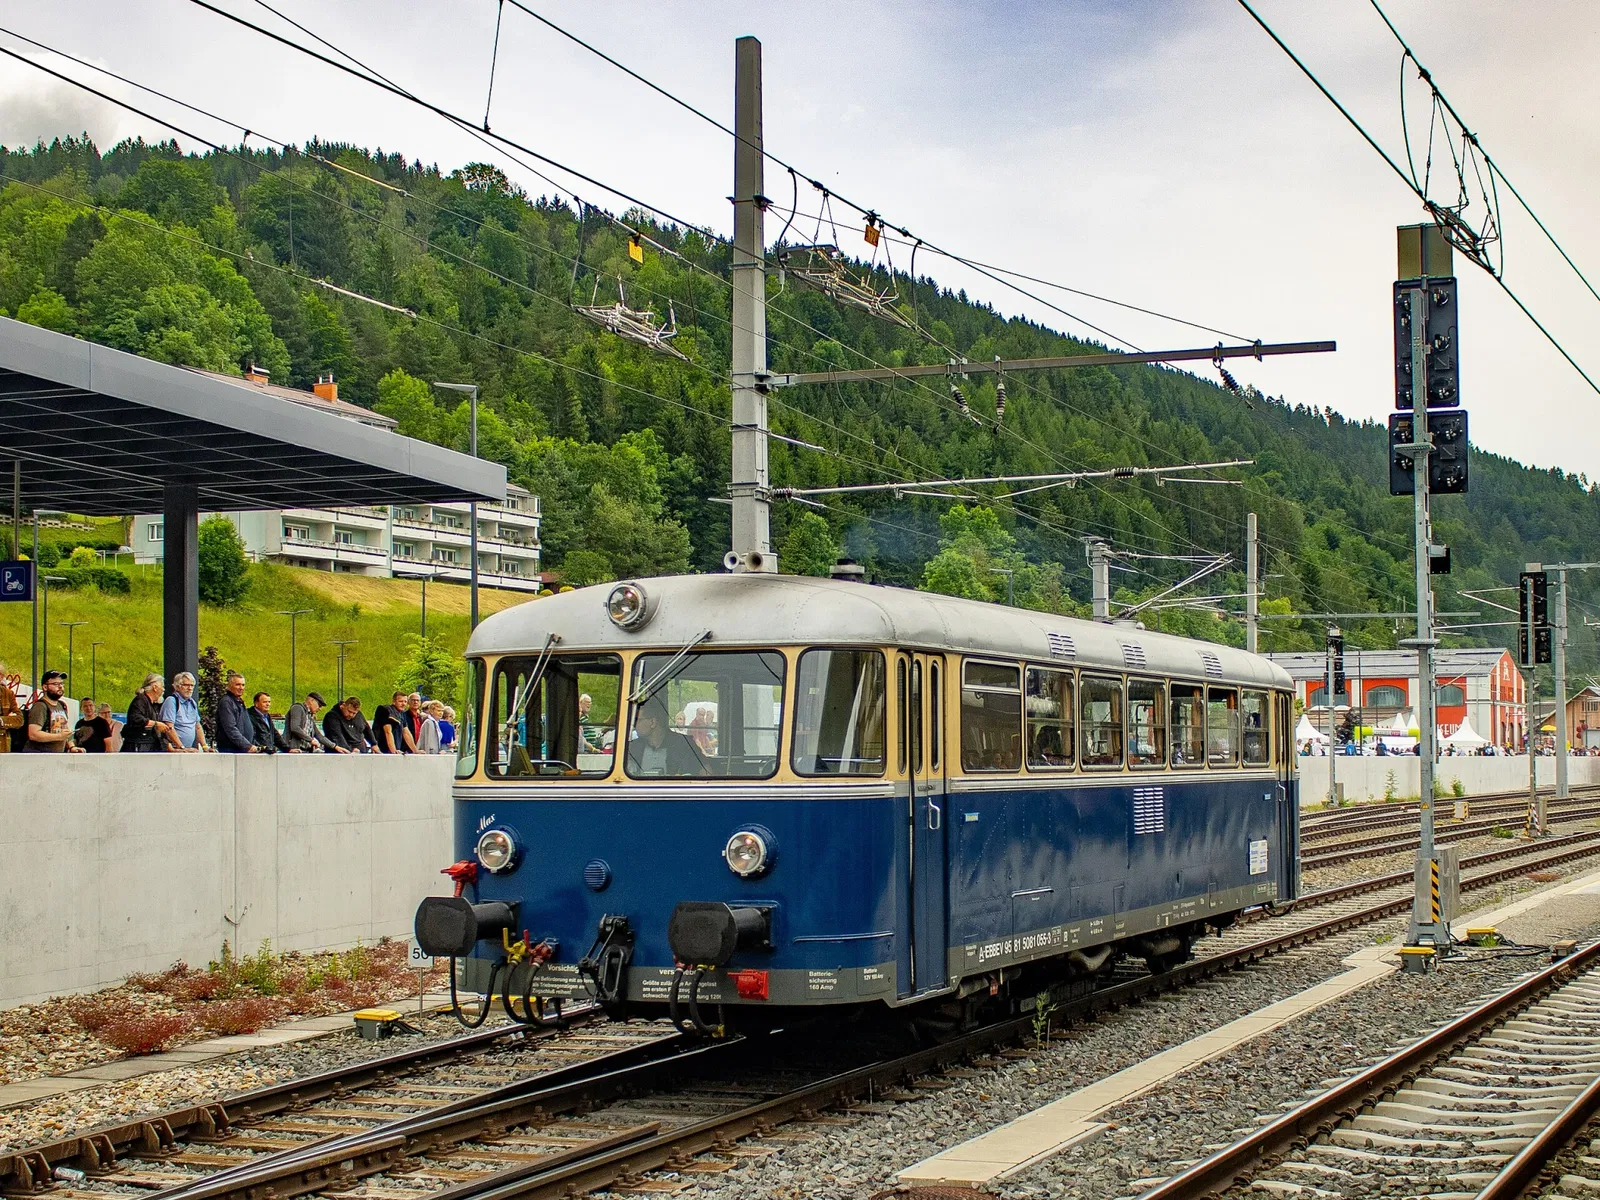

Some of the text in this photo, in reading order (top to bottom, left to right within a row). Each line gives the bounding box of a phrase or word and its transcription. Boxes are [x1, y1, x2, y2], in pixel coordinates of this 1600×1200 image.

[5, 571, 12, 583] P
[476, 813, 496, 834] Max
[1005, 940, 1012, 954] 95
[1014, 939, 1021, 952] 81
[1022, 936, 1036, 950] 5081
[547, 964, 580, 974] Vorsichtig
